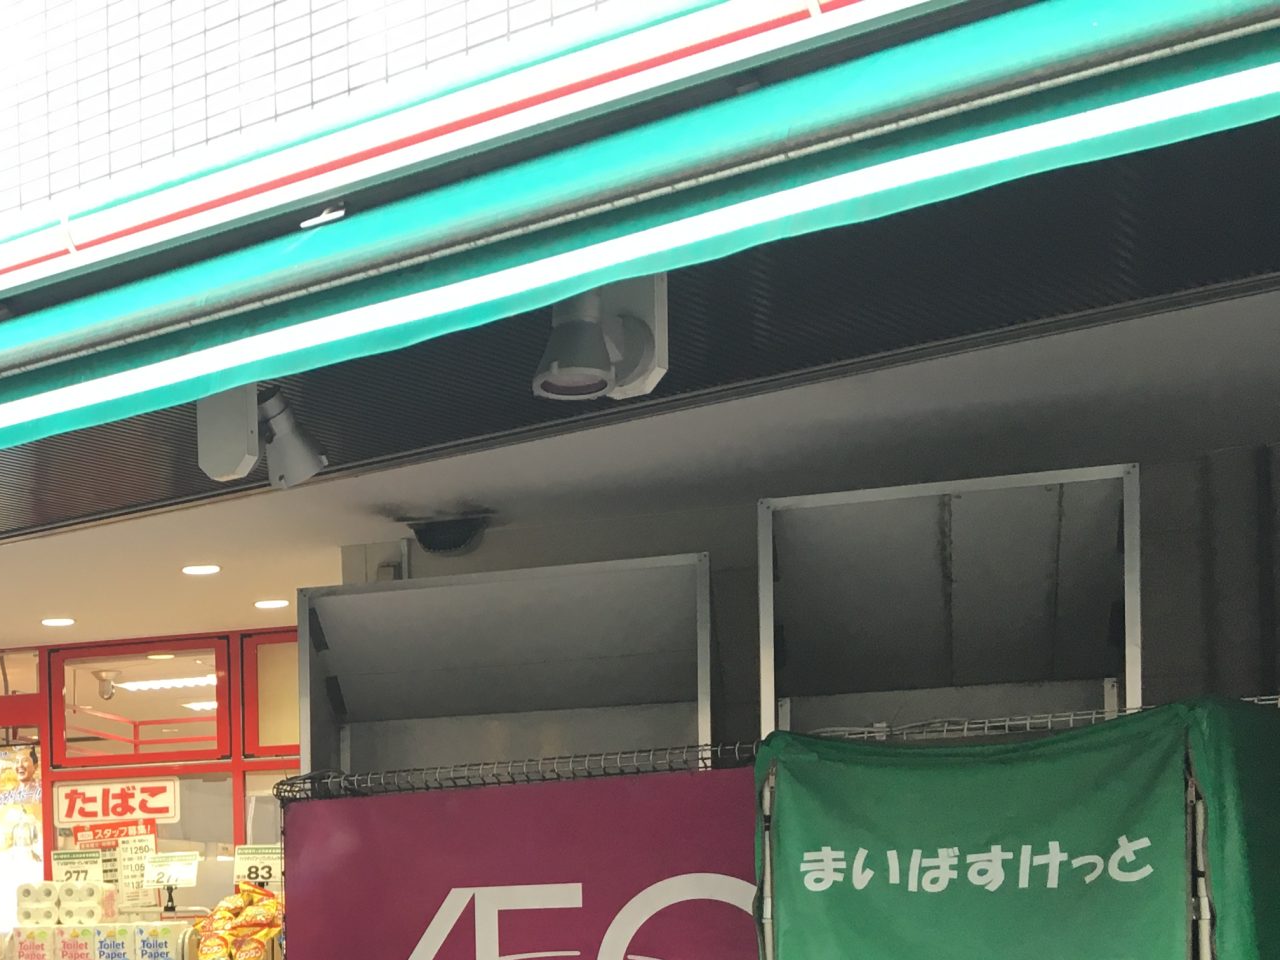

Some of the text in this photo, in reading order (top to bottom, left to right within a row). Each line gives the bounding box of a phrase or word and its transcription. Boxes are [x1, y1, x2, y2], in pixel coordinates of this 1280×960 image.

[64, 785, 170, 818] たばこ
[800, 834, 1154, 892] まいばすけっと
[64, 870, 88, 882] 277
[247, 865, 273, 880] 83
[19, 941, 45, 951] Toilet
[61, 940, 88, 950] Toilet
[98, 940, 125, 949] Toilet
[141, 940, 168, 949] Toilet
[18, 951, 46, 960] Paper
[61, 950, 90, 960] Paper
[99, 950, 127, 960] Paper
[141, 950, 169, 960] Paper
